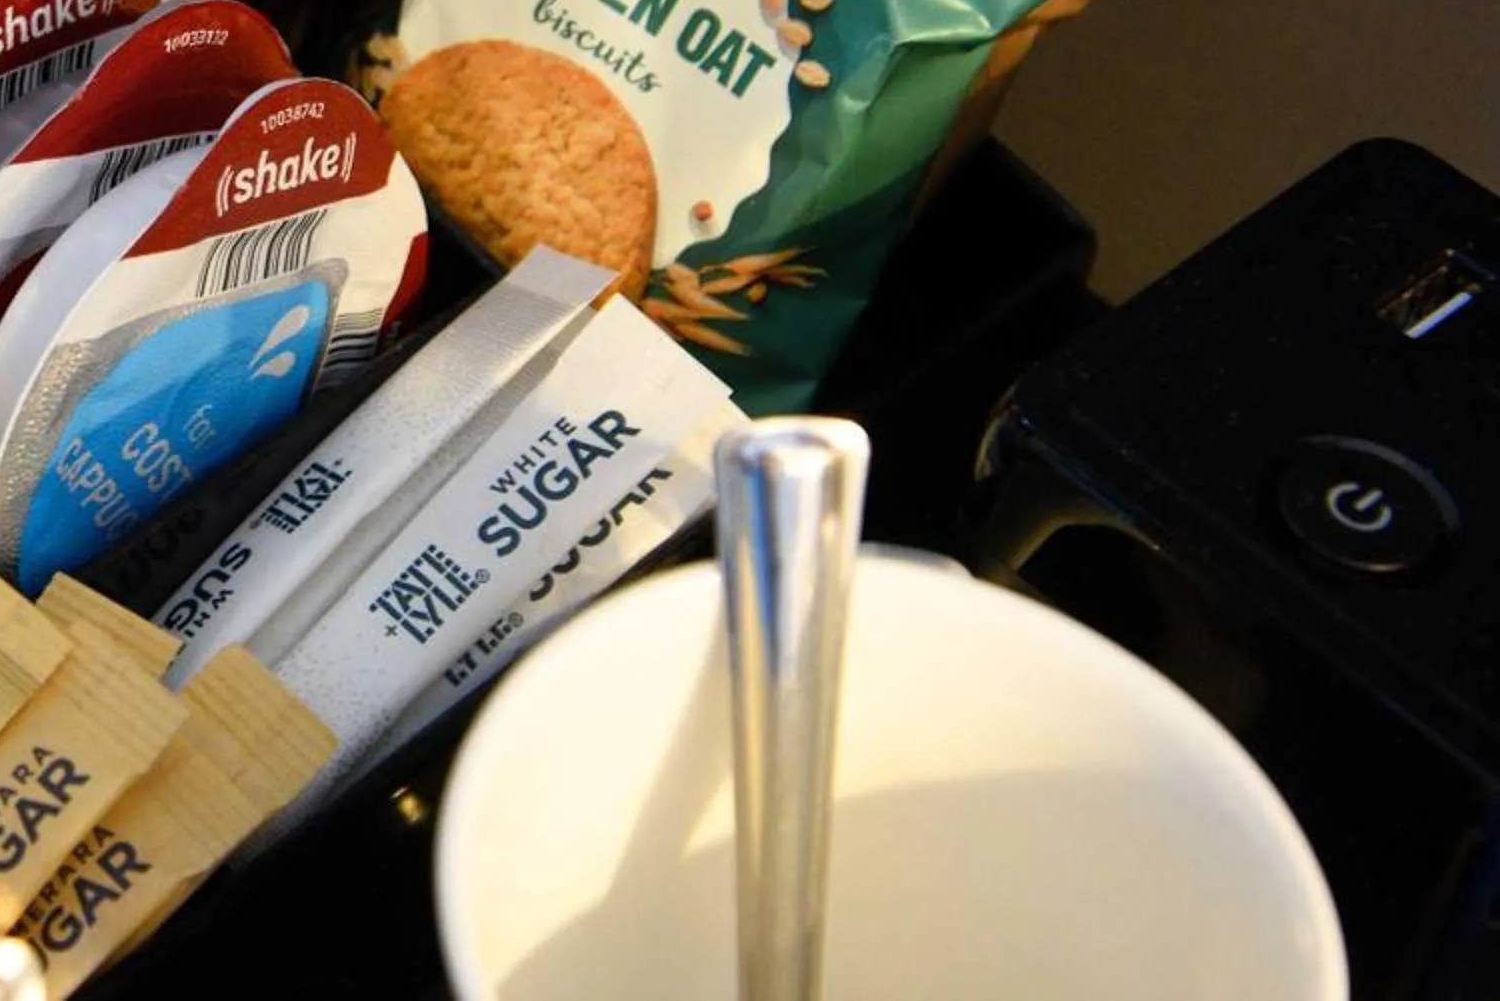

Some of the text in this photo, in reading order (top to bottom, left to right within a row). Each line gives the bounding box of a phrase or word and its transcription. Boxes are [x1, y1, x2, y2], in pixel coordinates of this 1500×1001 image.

[675, 8, 777, 99] OAT
[477, 409, 643, 558] SUGAR
[490, 417, 578, 495] WHITE
